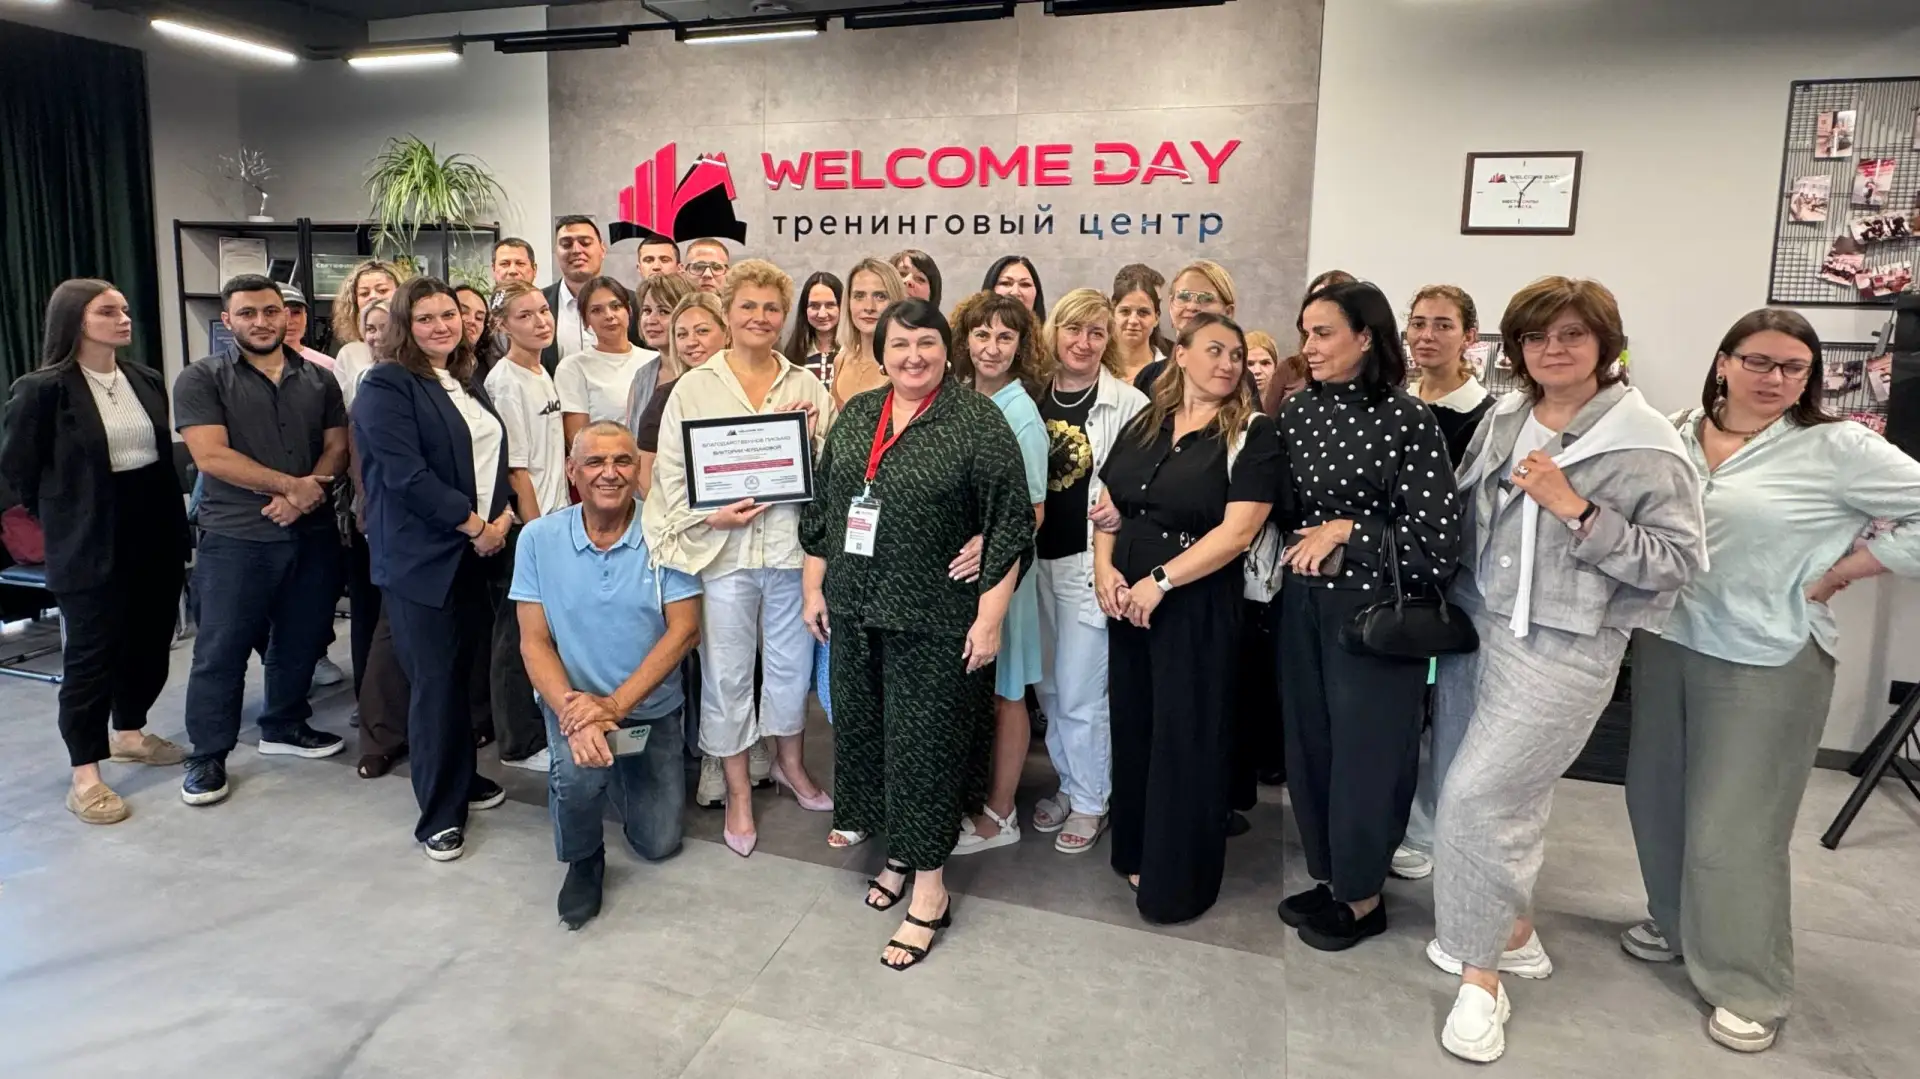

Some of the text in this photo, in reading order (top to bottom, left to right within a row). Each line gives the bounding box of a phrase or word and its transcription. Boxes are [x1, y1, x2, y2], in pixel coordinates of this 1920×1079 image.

[761, 140, 1241, 190] WELCOME DAY
[772, 204, 1223, 243] тренинговый центр
